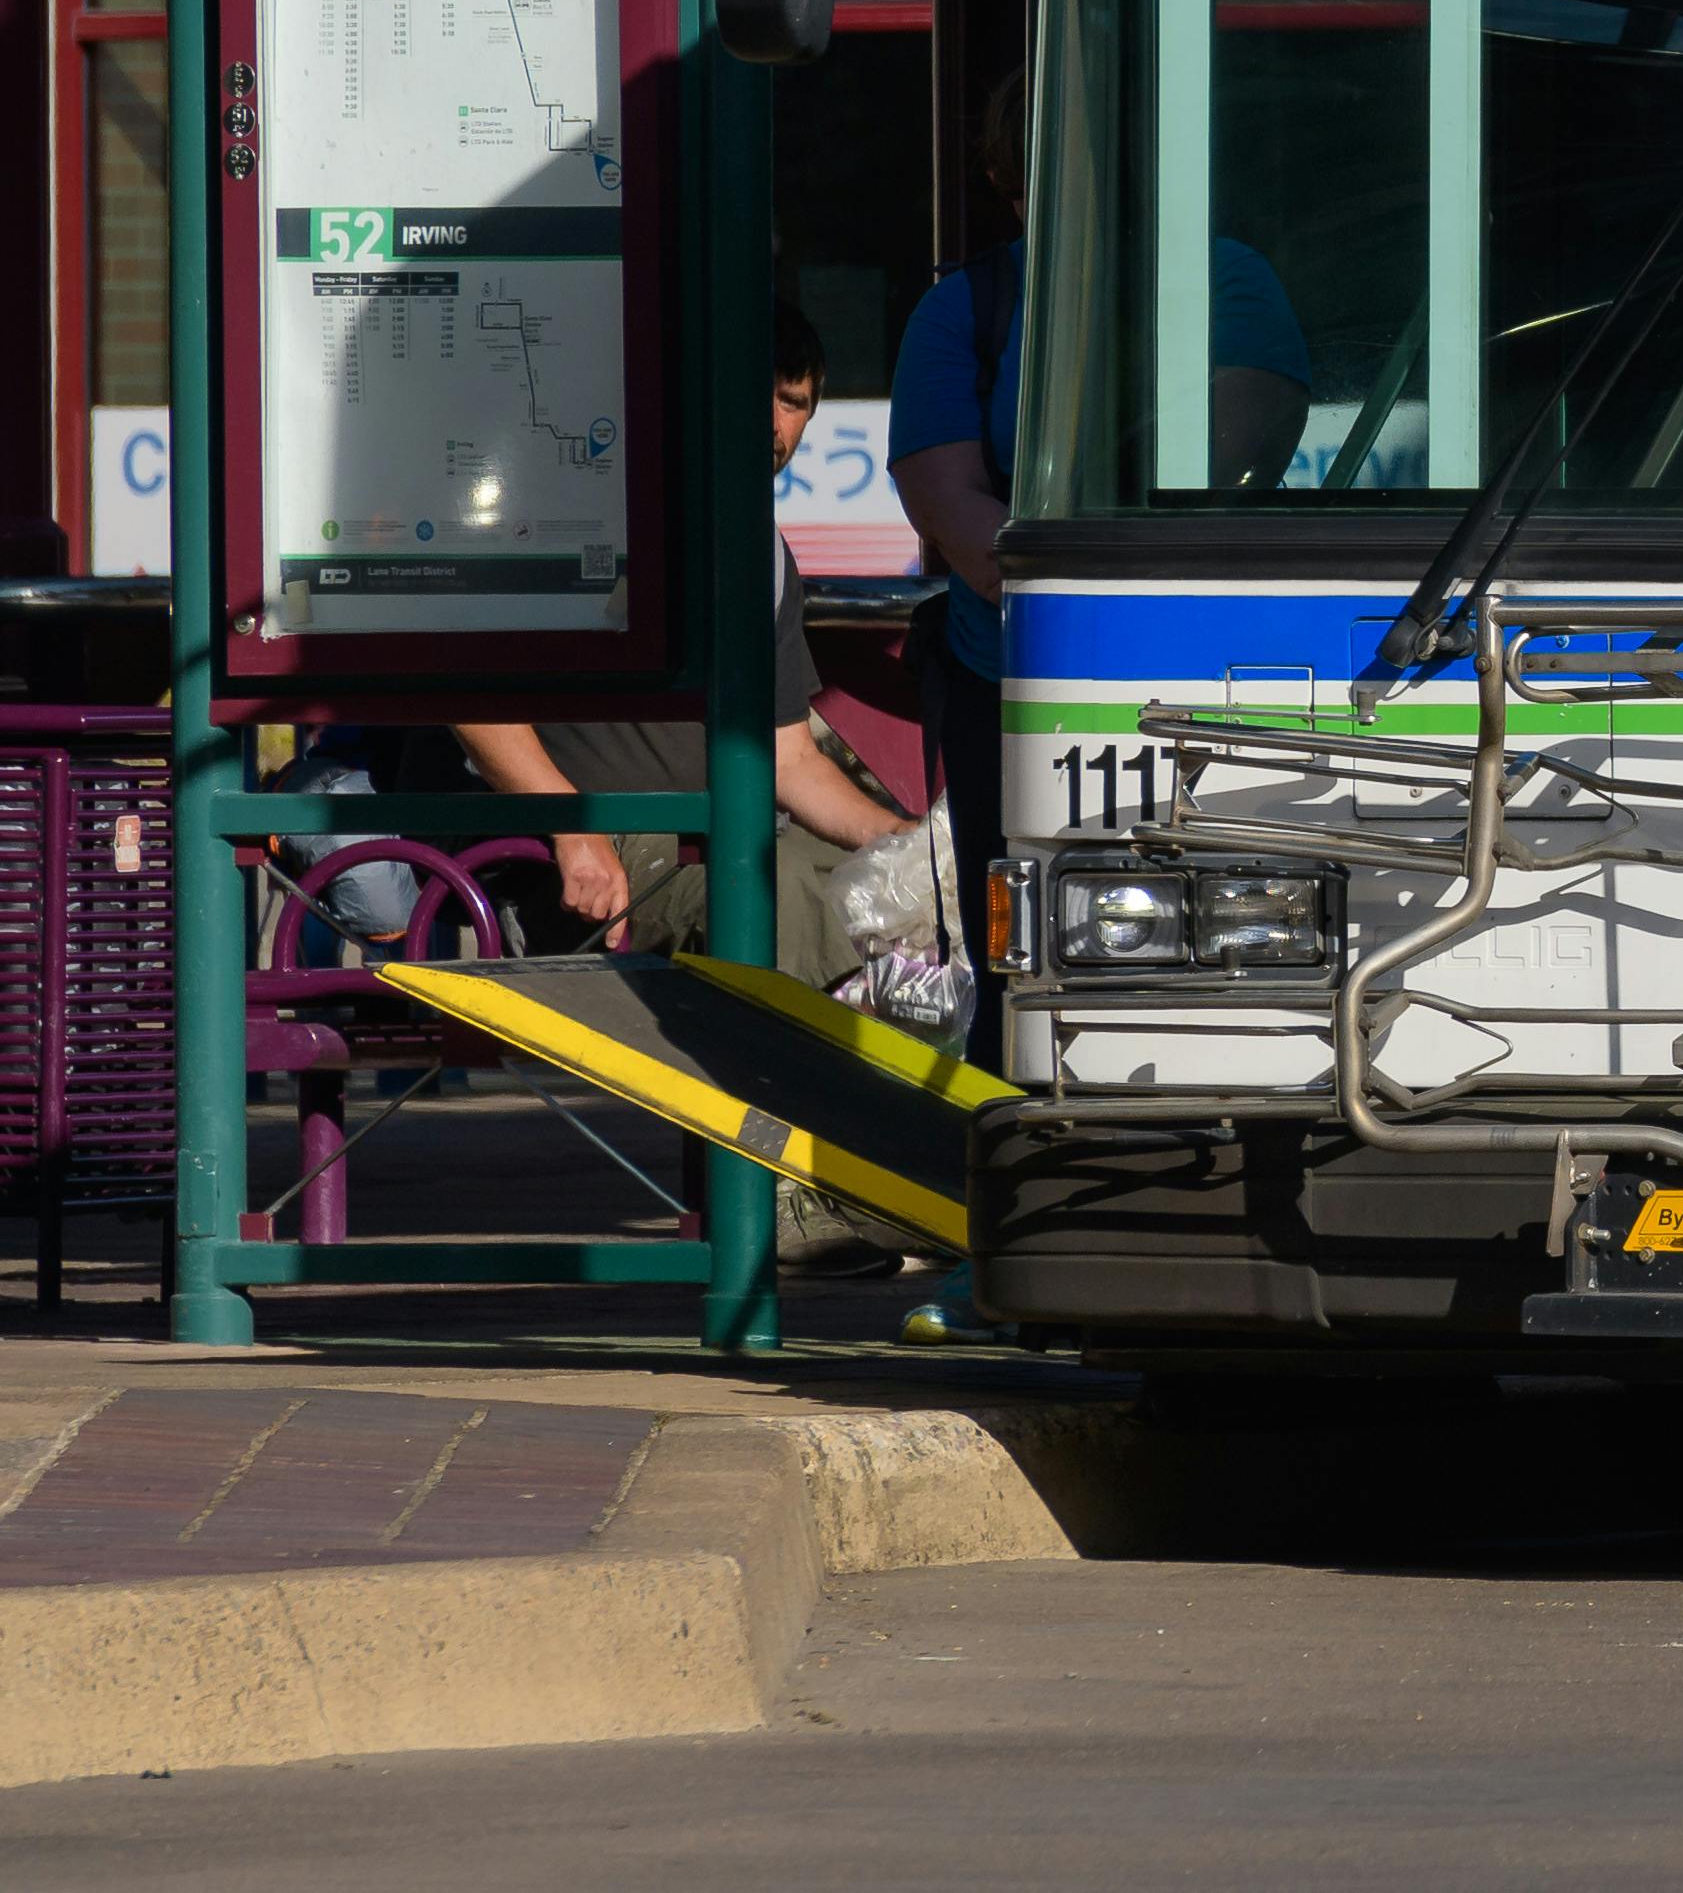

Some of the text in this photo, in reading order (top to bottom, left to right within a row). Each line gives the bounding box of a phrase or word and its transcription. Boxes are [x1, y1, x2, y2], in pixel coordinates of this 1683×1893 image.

[320, 210, 468, 263] 52 IRVING
[391, 566, 421, 576] Transit
[423, 566, 456, 576] District
